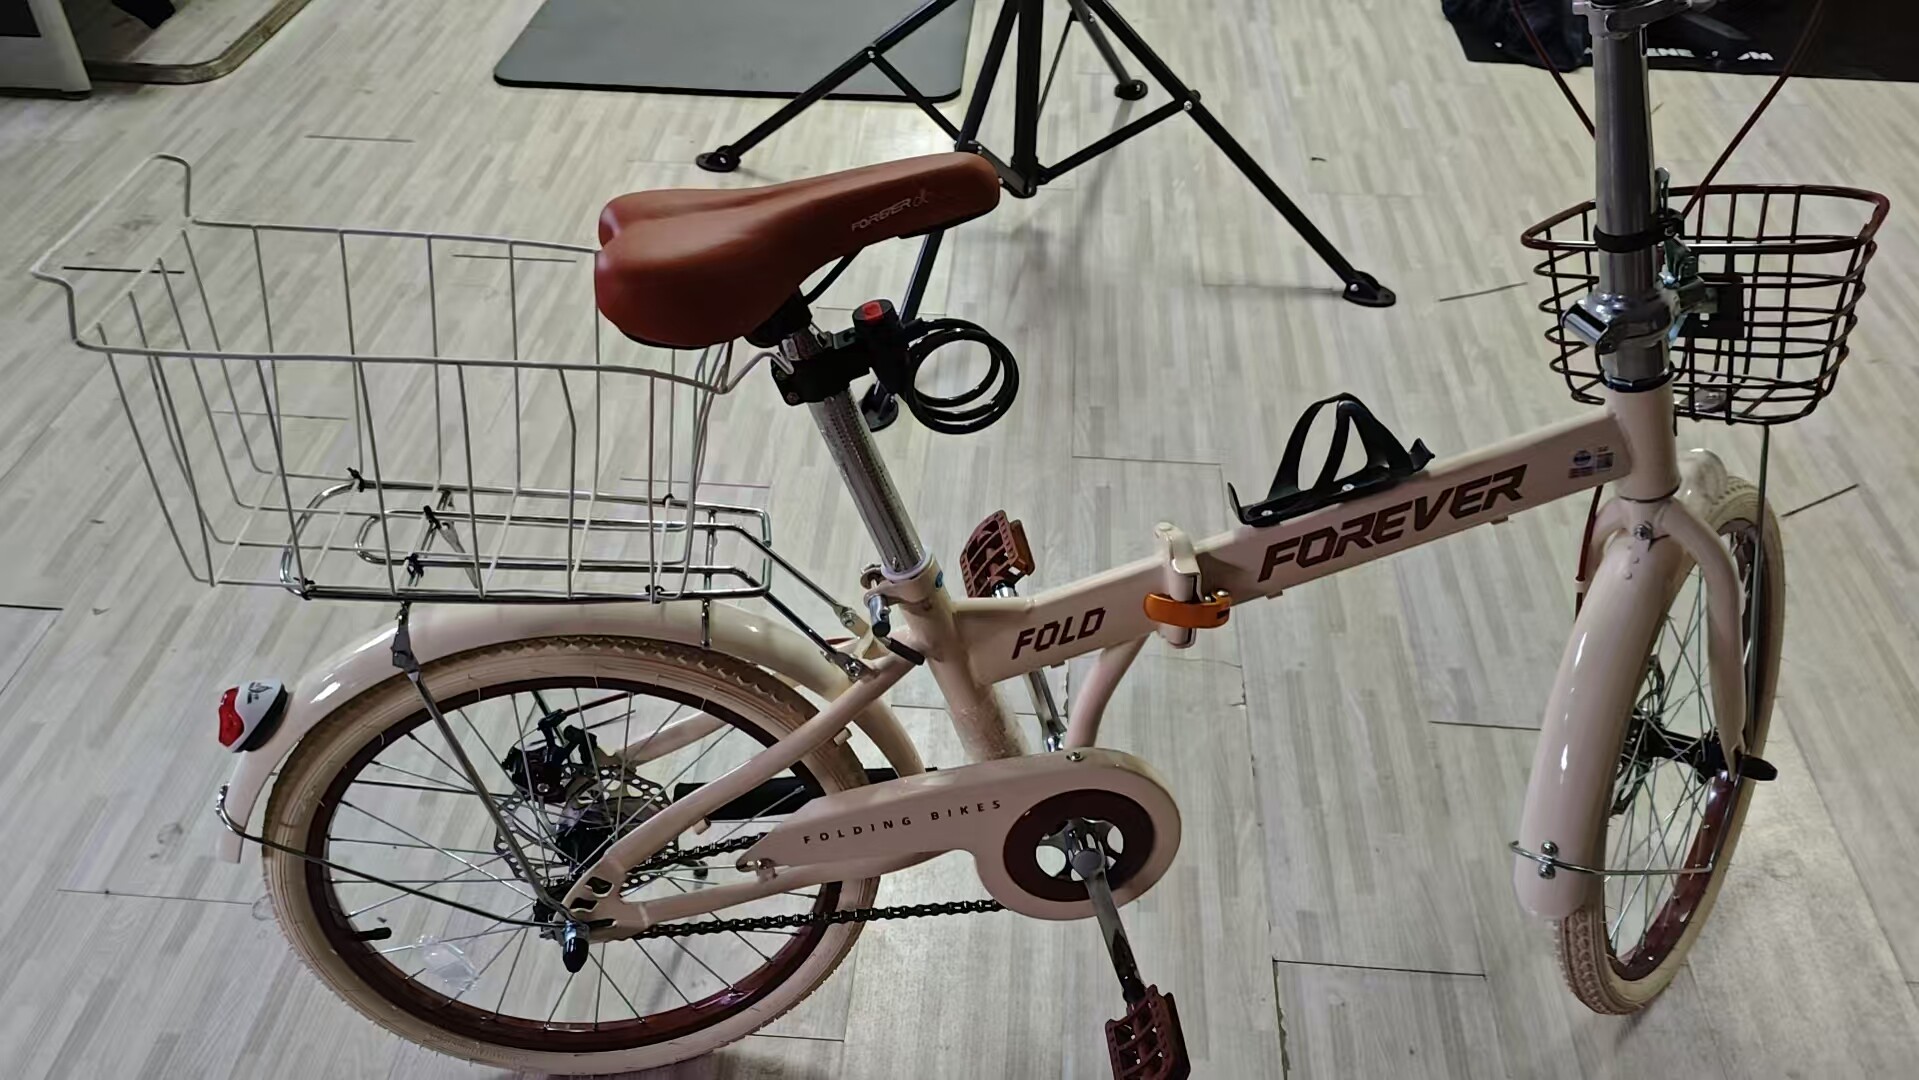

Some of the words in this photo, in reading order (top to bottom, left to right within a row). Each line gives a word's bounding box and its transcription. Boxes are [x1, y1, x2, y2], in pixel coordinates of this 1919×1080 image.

[1257, 464, 1528, 583] FOREVER
[1011, 606, 1107, 660] FOLD
[803, 816, 912, 844] FOLDING
[930, 800, 1001, 821] BIKES
